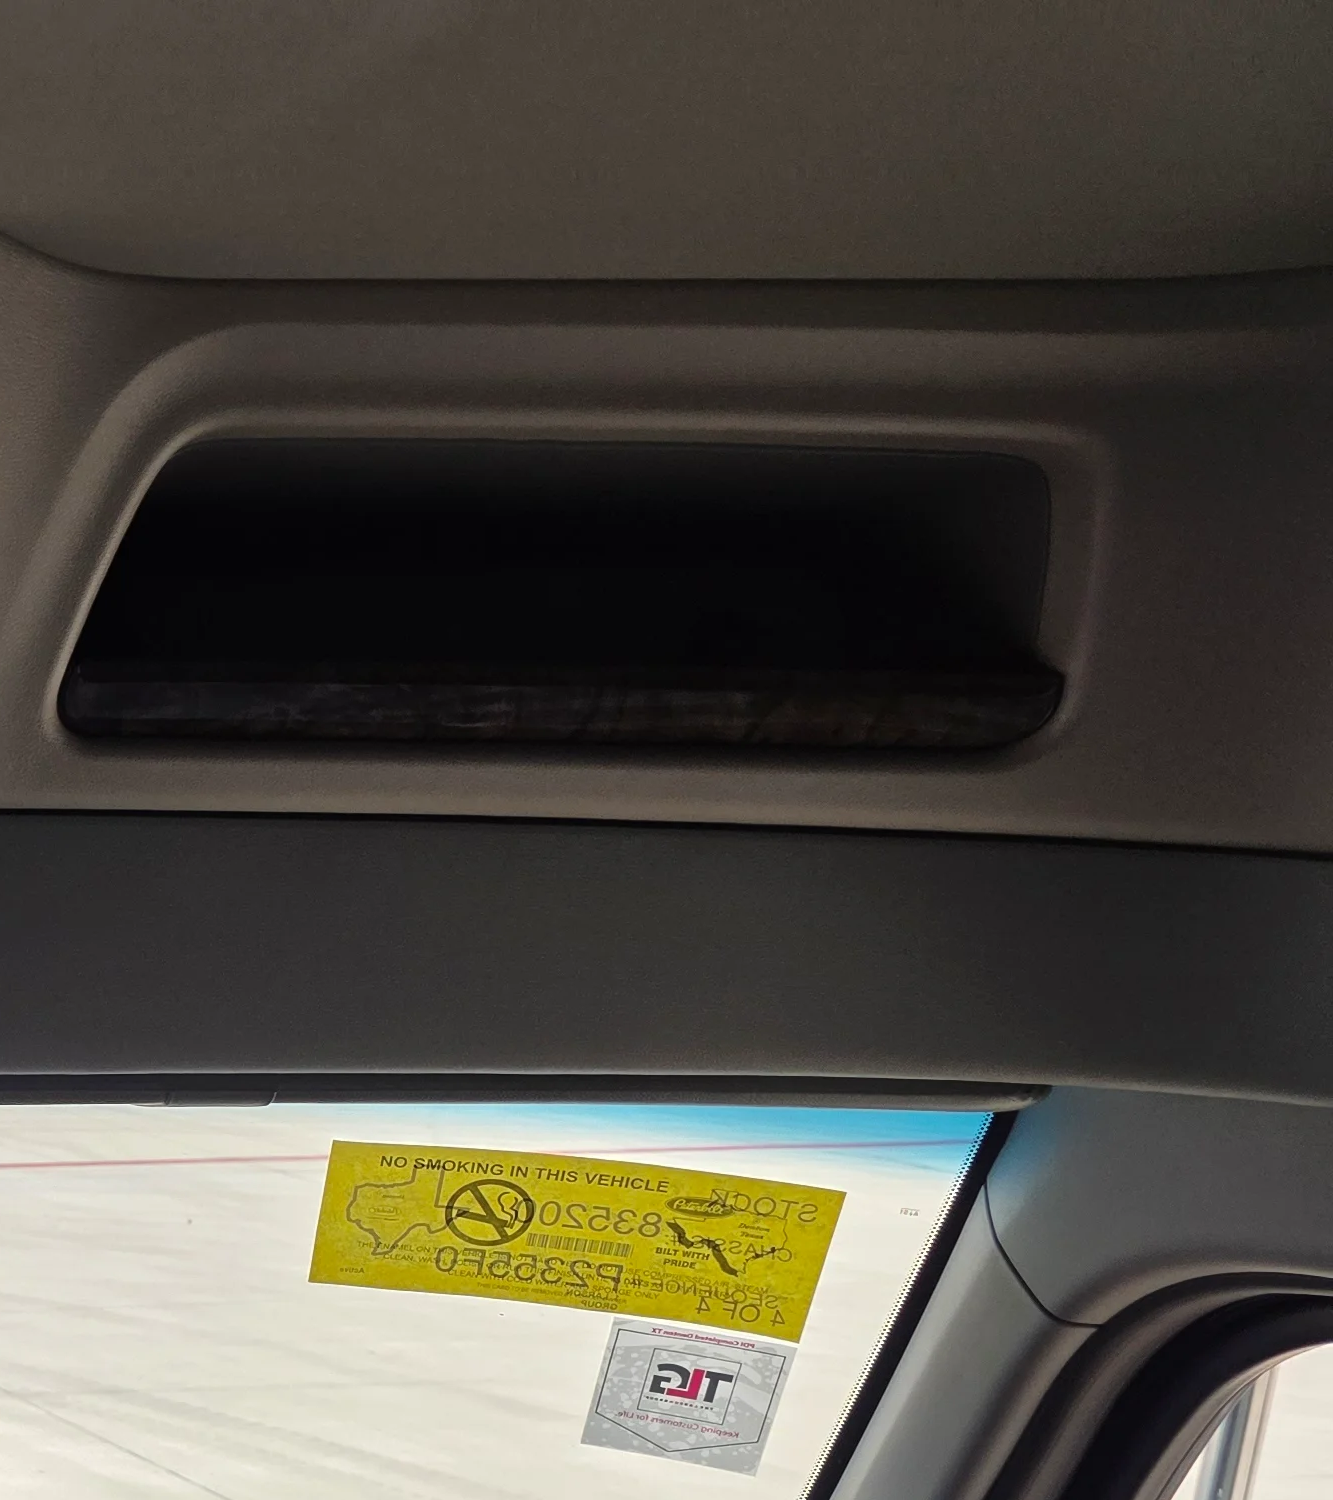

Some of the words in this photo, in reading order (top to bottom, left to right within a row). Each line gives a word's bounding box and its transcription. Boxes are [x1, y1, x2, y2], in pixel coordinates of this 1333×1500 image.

[380, 1155, 407, 1168] NO
[414, 1157, 504, 1175] SMOKING
[509, 1165, 529, 1178] IN
[535, 1167, 578, 1182] THIS
[584, 1172, 670, 1193] VEHICLE
[655, 1246, 678, 1257] BILT
[682, 1249, 711, 1261] WITH
[663, 1257, 697, 1269] PRIDE
